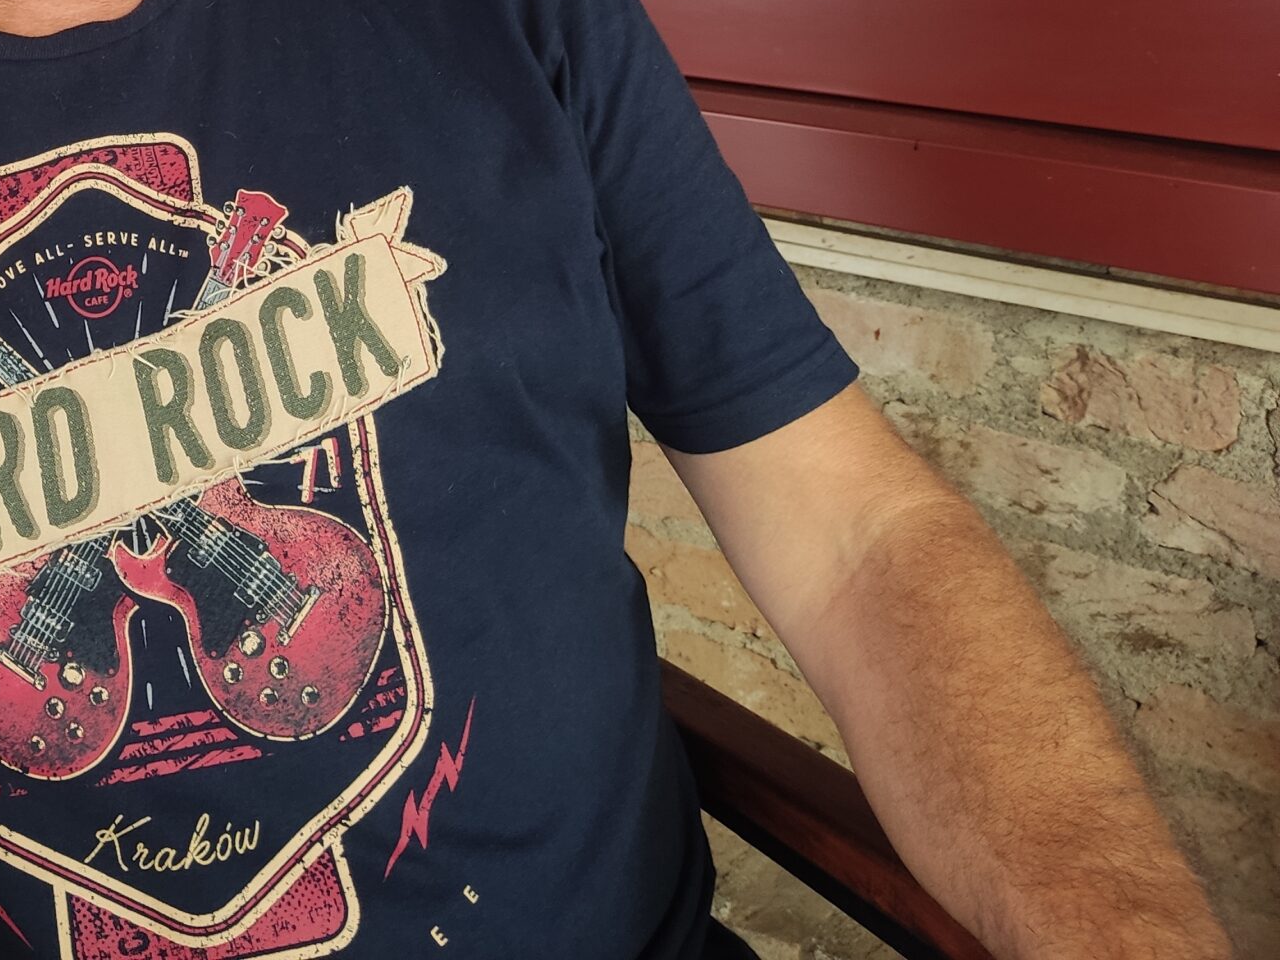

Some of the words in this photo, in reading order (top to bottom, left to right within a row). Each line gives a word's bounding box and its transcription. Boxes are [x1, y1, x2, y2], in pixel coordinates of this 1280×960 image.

[84, 231, 139, 248] SERVE
[45, 271, 93, 300] Hard
[95, 264, 139, 290] Rock
[84, 295, 109, 308] CAFE
[133, 253, 403, 484] ROCK
[84, 812, 260, 872] Kraków
